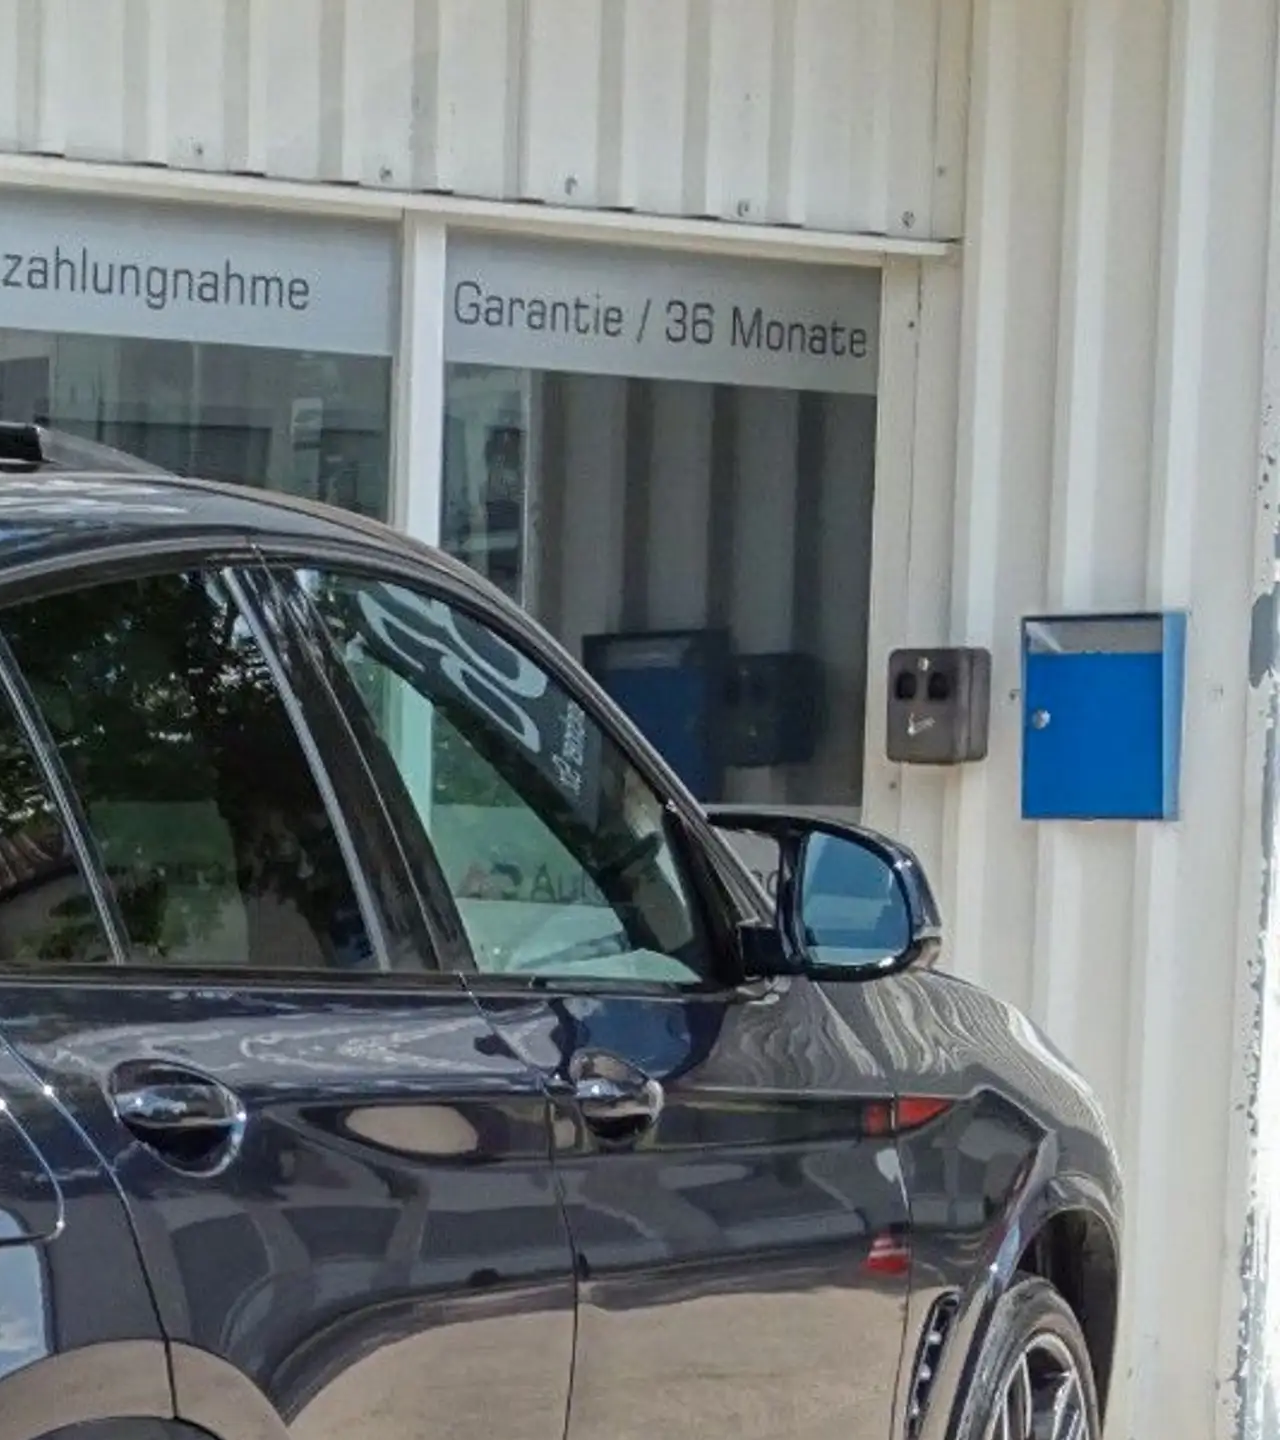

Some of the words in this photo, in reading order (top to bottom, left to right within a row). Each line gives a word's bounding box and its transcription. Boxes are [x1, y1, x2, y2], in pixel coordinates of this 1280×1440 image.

[452, 280, 624, 338] Garantie
[636, 299, 652, 345] /
[665, 299, 716, 346] 36
[730, 307, 869, 359] Monate
